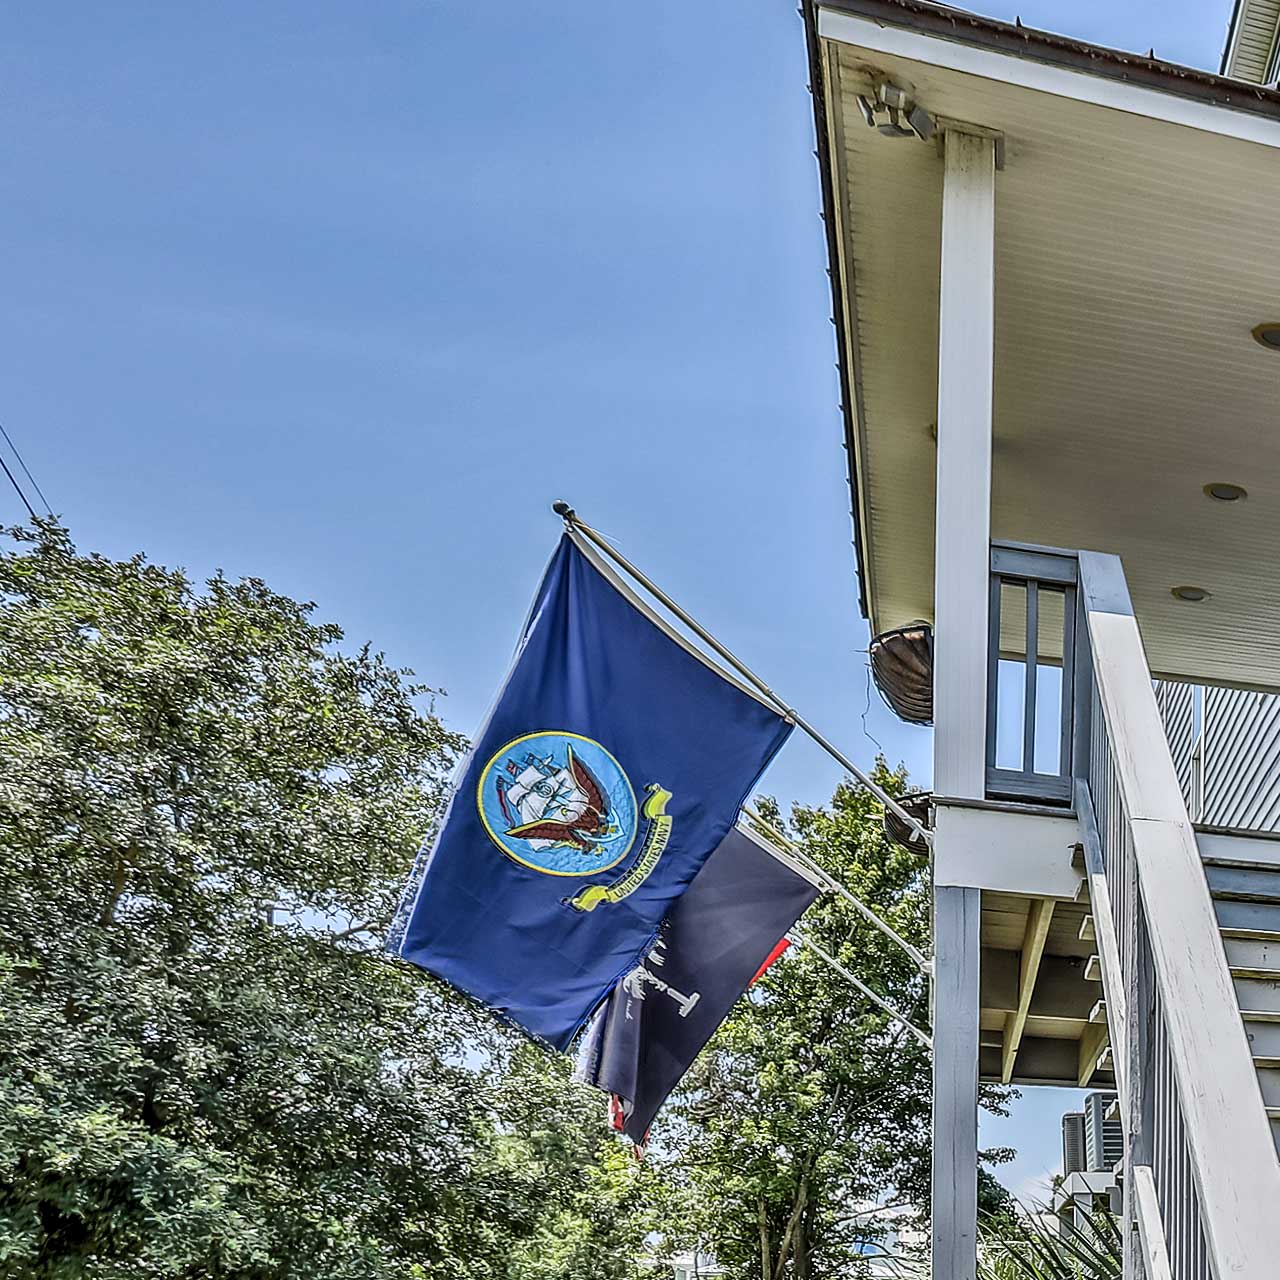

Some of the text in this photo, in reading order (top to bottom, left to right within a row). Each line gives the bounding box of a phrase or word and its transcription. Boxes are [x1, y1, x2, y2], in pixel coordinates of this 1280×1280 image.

[614, 821, 670, 898] UNITED STATES NAVY
